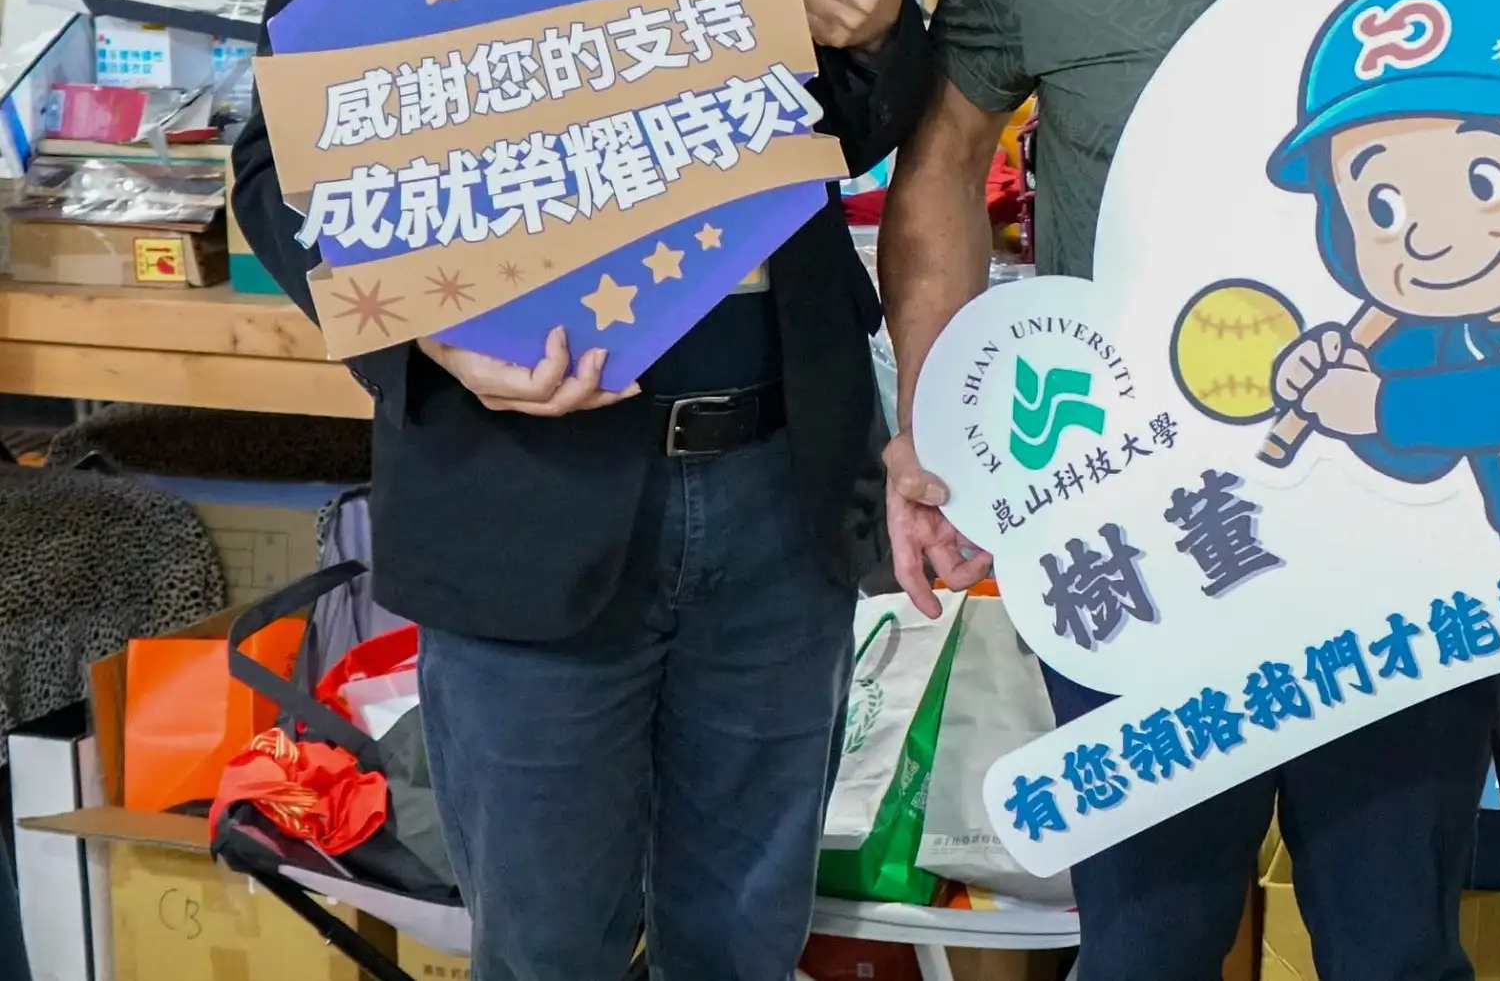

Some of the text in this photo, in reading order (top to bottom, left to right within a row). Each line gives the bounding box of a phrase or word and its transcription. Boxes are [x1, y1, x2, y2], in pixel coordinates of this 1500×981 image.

[294, 63, 825, 251] 成就榮耀時刻
[962, 317, 1136, 474] KUN SHAN UNIVERSITY
[992, 411, 1179, 535] 崑山科技大學
[1040, 468, 1286, 651] 樹董
